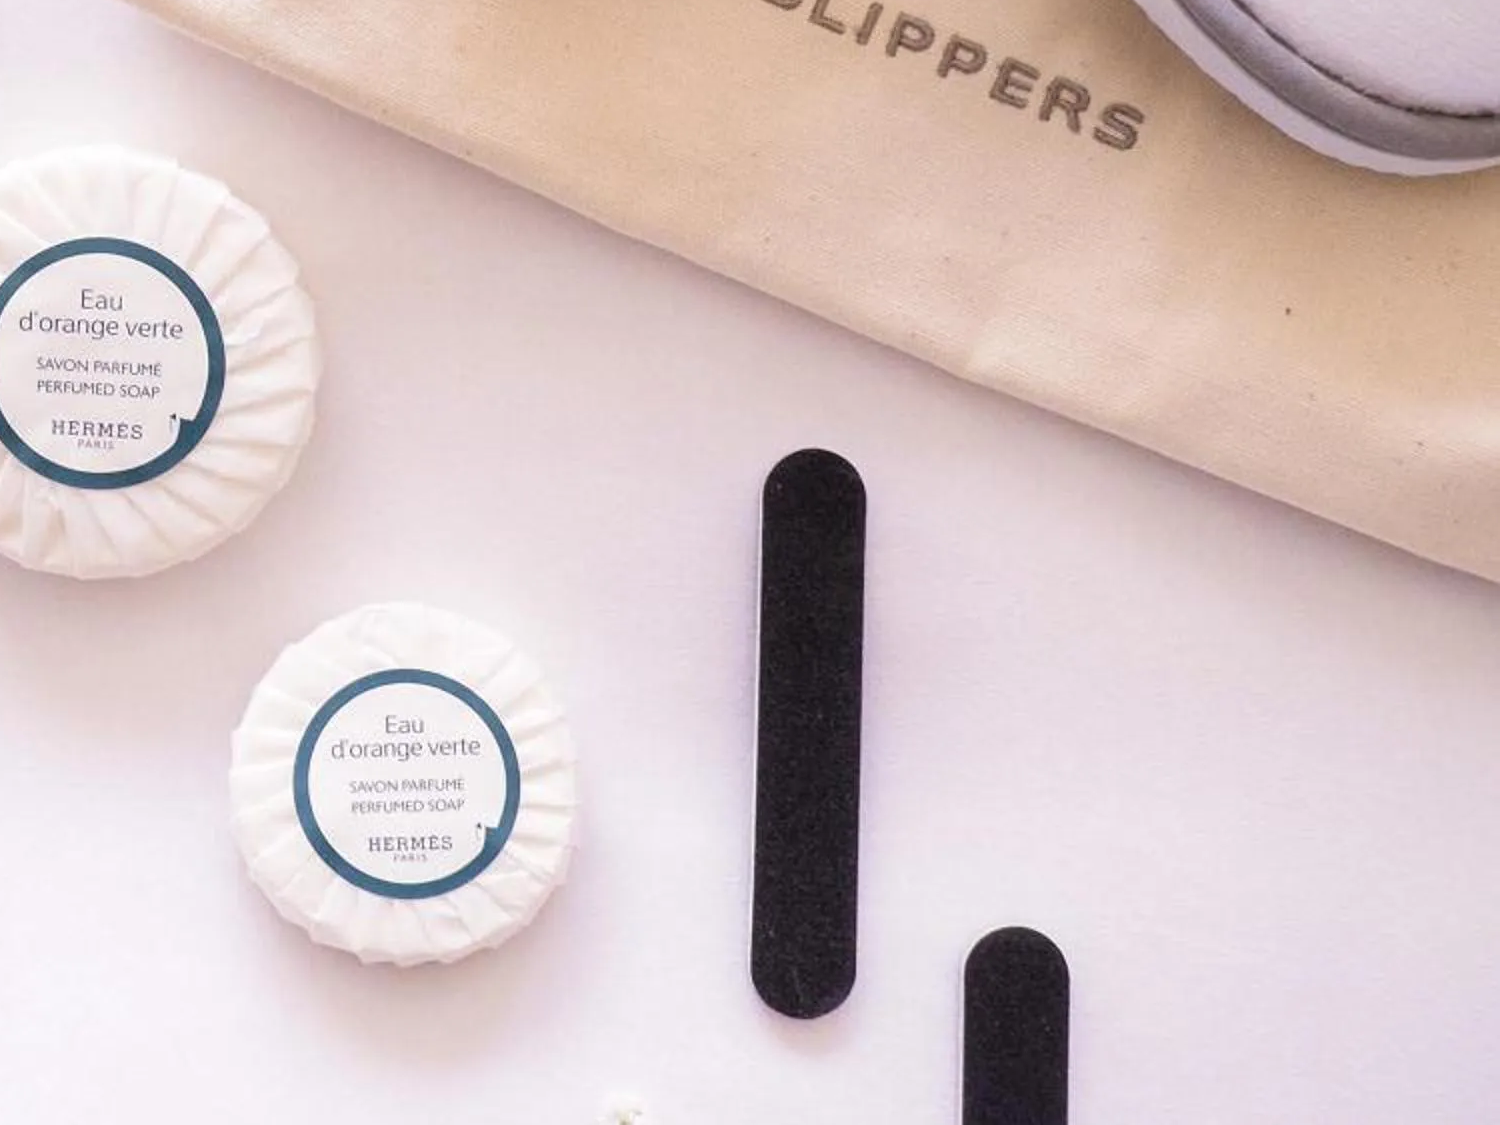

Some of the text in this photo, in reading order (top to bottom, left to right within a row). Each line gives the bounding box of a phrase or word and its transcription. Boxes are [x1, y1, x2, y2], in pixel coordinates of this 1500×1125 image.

[81, 288, 123, 310] Eau
[19, 311, 183, 340] d'orange verte
[37, 356, 162, 377] SAVON PARFUMÉ
[37, 381, 161, 399] PERFUMED SOAP
[78, 439, 115, 450] PARIS
[385, 715, 425, 734] Eau
[331, 739, 481, 761] d'orange verte
[349, 780, 399, 793] SAVON
[351, 799, 465, 814] PERFUMED SOAP
[394, 853, 427, 862] PARIS
